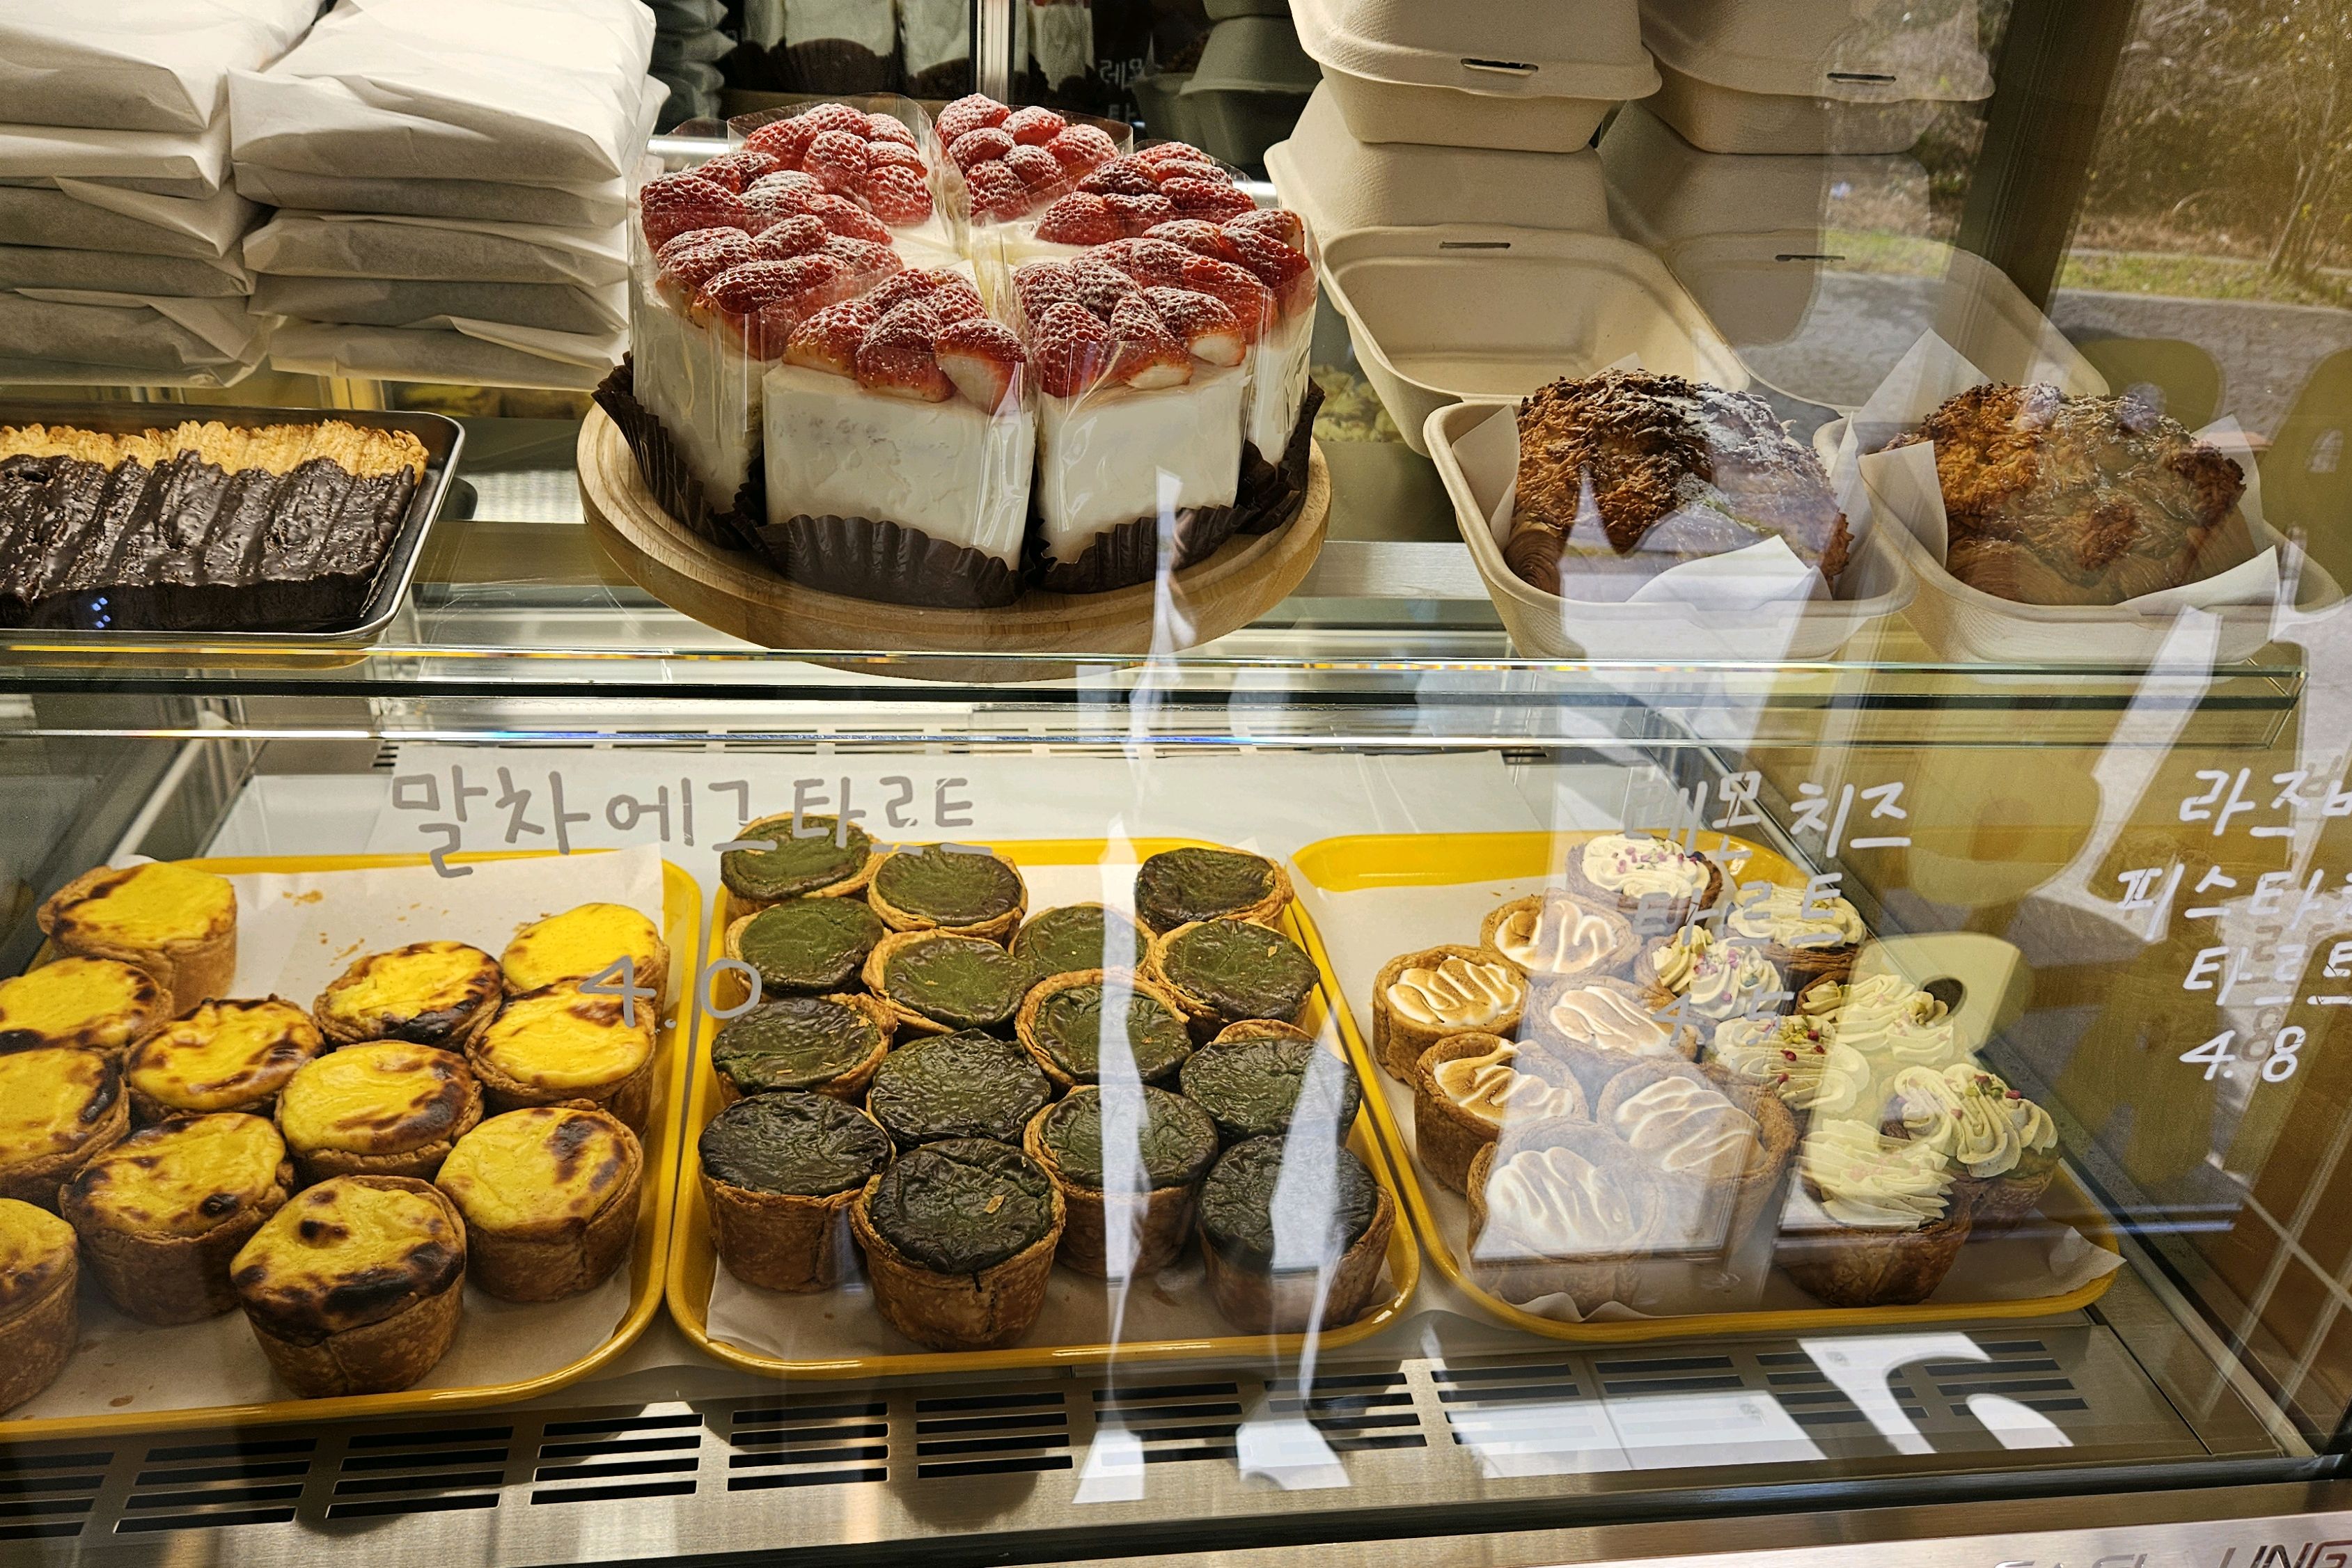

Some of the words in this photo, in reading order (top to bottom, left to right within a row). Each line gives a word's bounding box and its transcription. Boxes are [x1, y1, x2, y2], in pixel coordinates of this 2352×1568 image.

[1631, 872, 1843, 950] 타르트
[578, 955, 762, 1029] 4.0
[2179, 1025, 2306, 1083] 4.8
